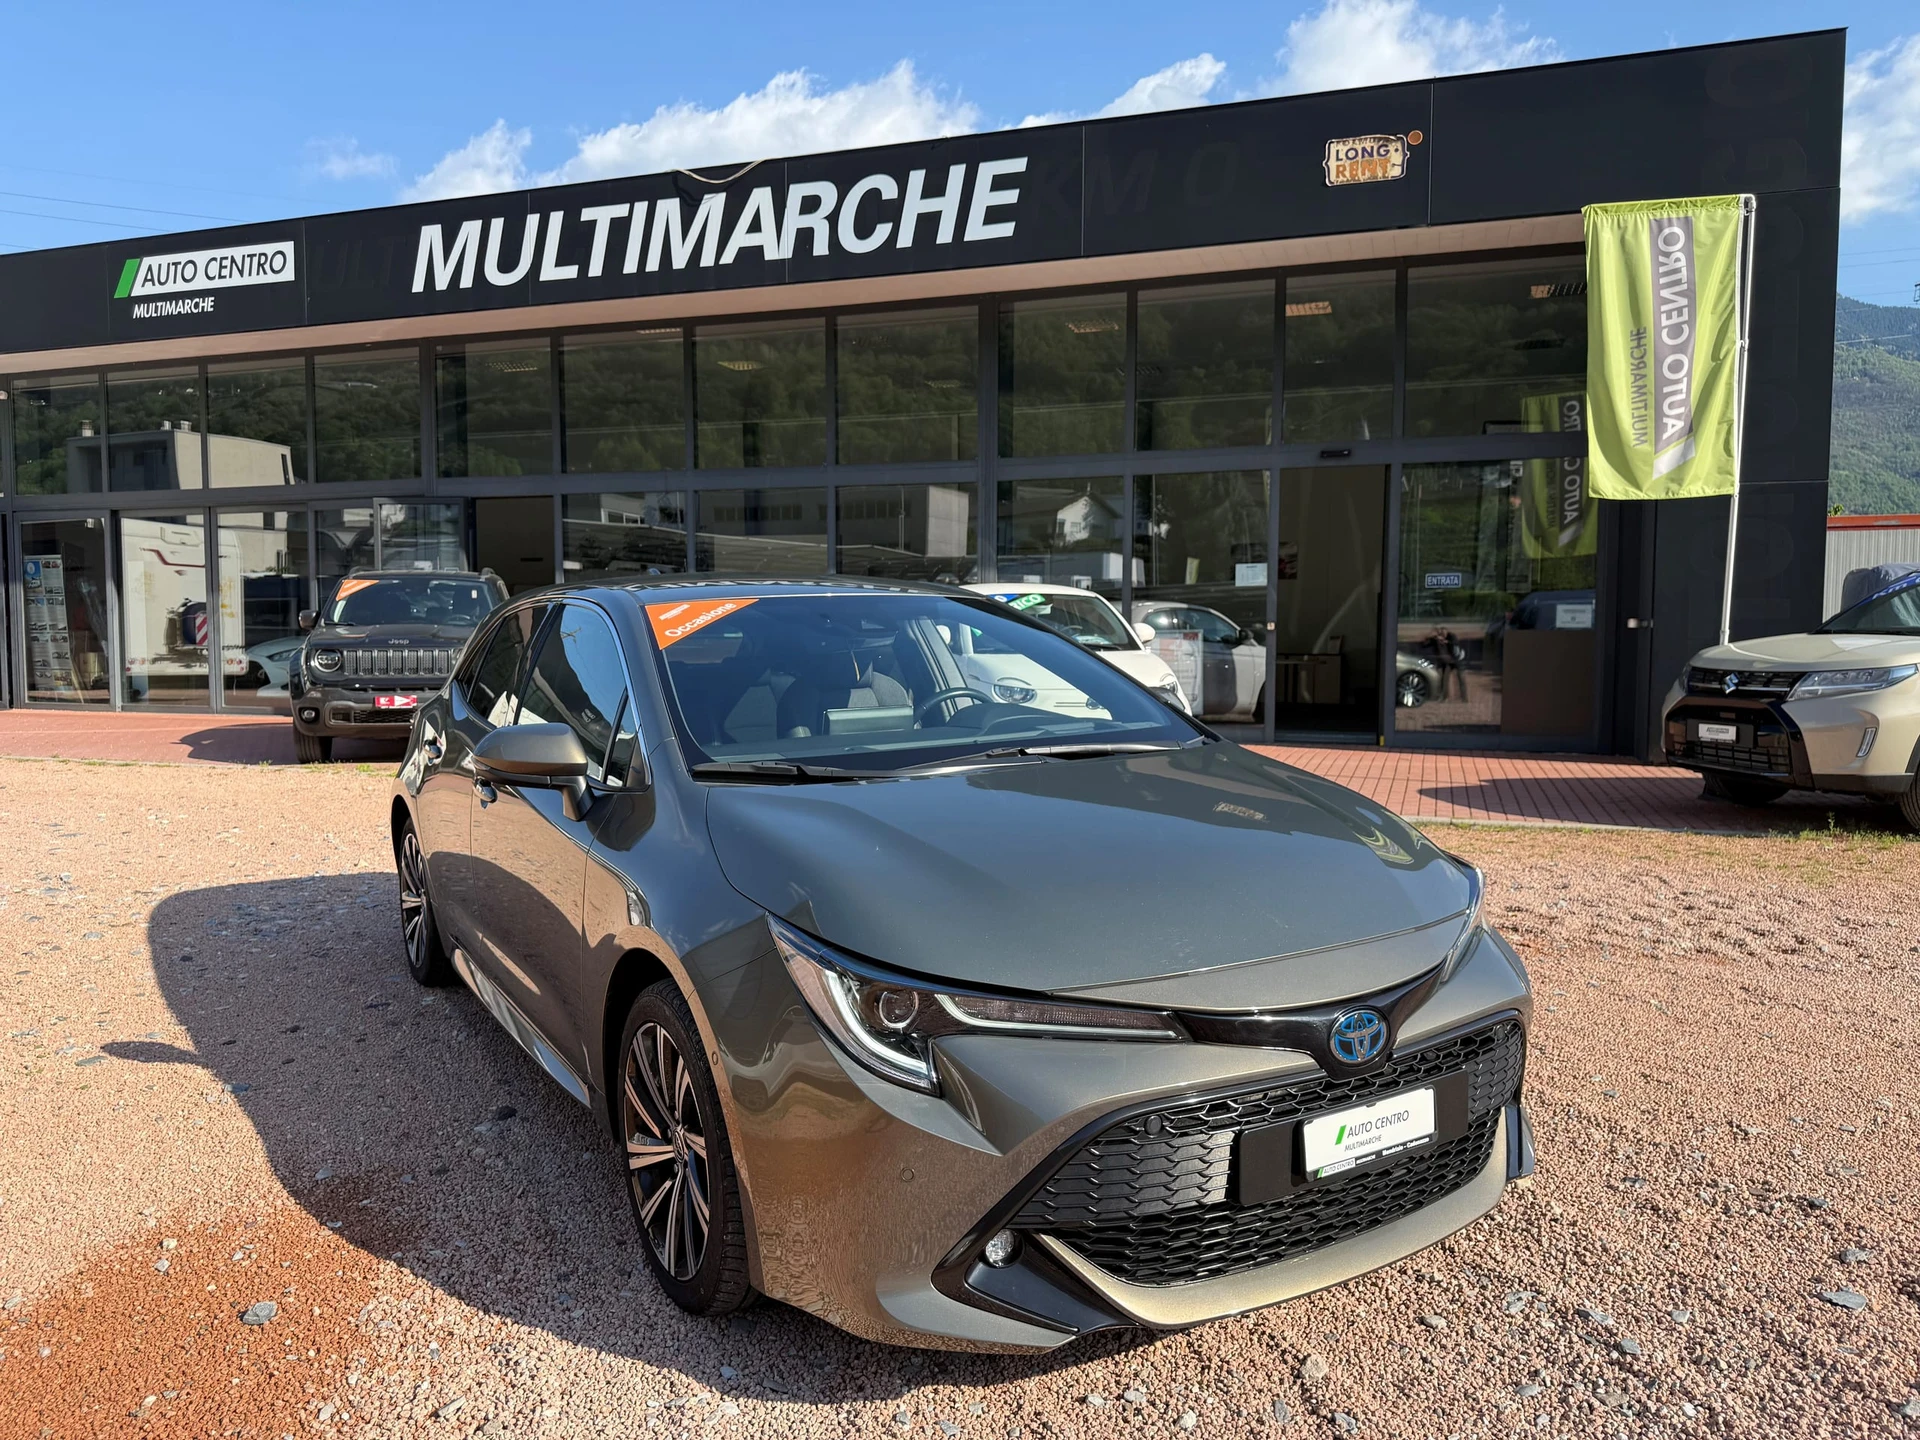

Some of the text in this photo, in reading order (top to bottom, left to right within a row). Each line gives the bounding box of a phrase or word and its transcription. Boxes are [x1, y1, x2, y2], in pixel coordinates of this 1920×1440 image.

[1335, 144, 1390, 162] LONG
[1335, 158, 1391, 180] RENT
[411, 156, 1028, 293] MULTIMARCHE
[141, 259, 198, 288] AUTO
[204, 250, 288, 281] CENTRO
[132, 297, 215, 319] MULTIMARCHE
[1426, 575, 1460, 587] ENTRATA
[664, 602, 737, 637] Occasione
[1347, 1110, 1409, 1138] AUTO CENTRO
[1344, 1135, 1382, 1152] MULTIMARCHE
